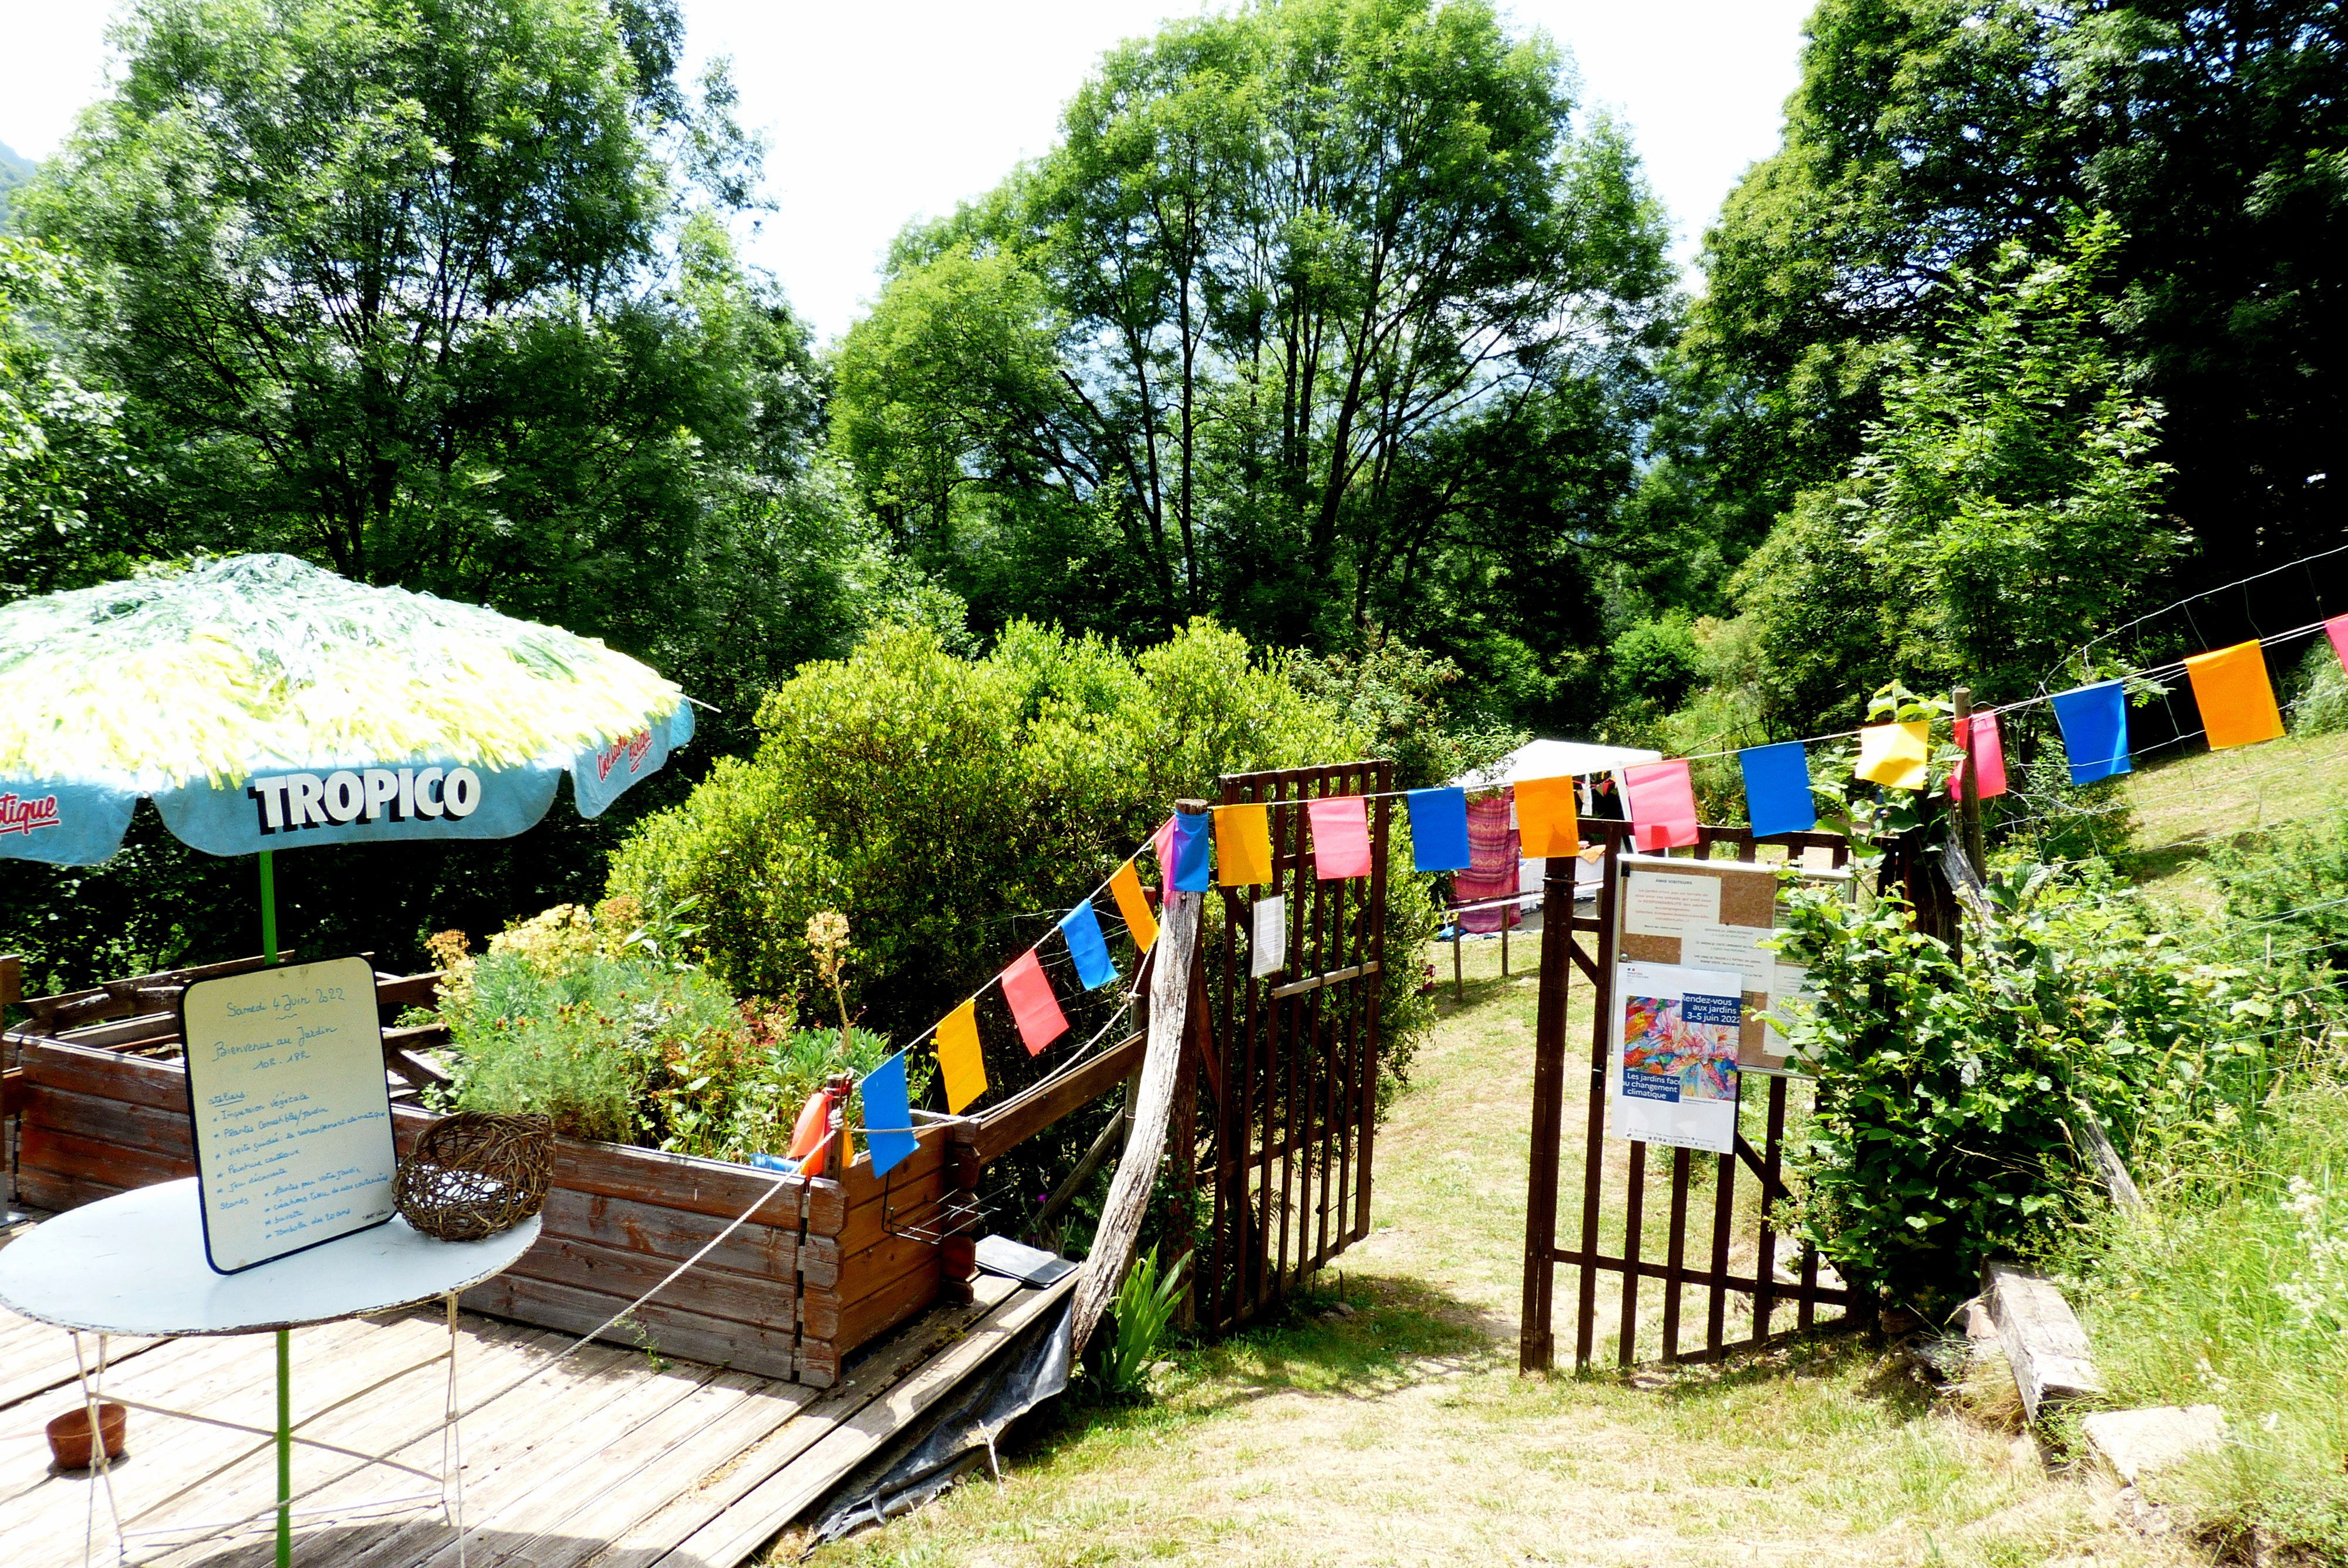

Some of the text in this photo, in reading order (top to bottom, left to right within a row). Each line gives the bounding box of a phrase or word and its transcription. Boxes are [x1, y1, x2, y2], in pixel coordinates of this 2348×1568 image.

[251, 767, 481, 832] TROPICO
[227, 987, 345, 1016] Samedi 4 Juin 2022
[1708, 1004, 1737, 1015] jardins
[1702, 1012, 1719, 1023] juin
[212, 1026, 338, 1062] Bienvenue au Jardin
[1627, 1072, 1639, 1080] Les
[1639, 1074, 1665, 1084] jardins
[1631, 1080, 1678, 1093] changement
[1627, 1087, 1666, 1100] climatique
